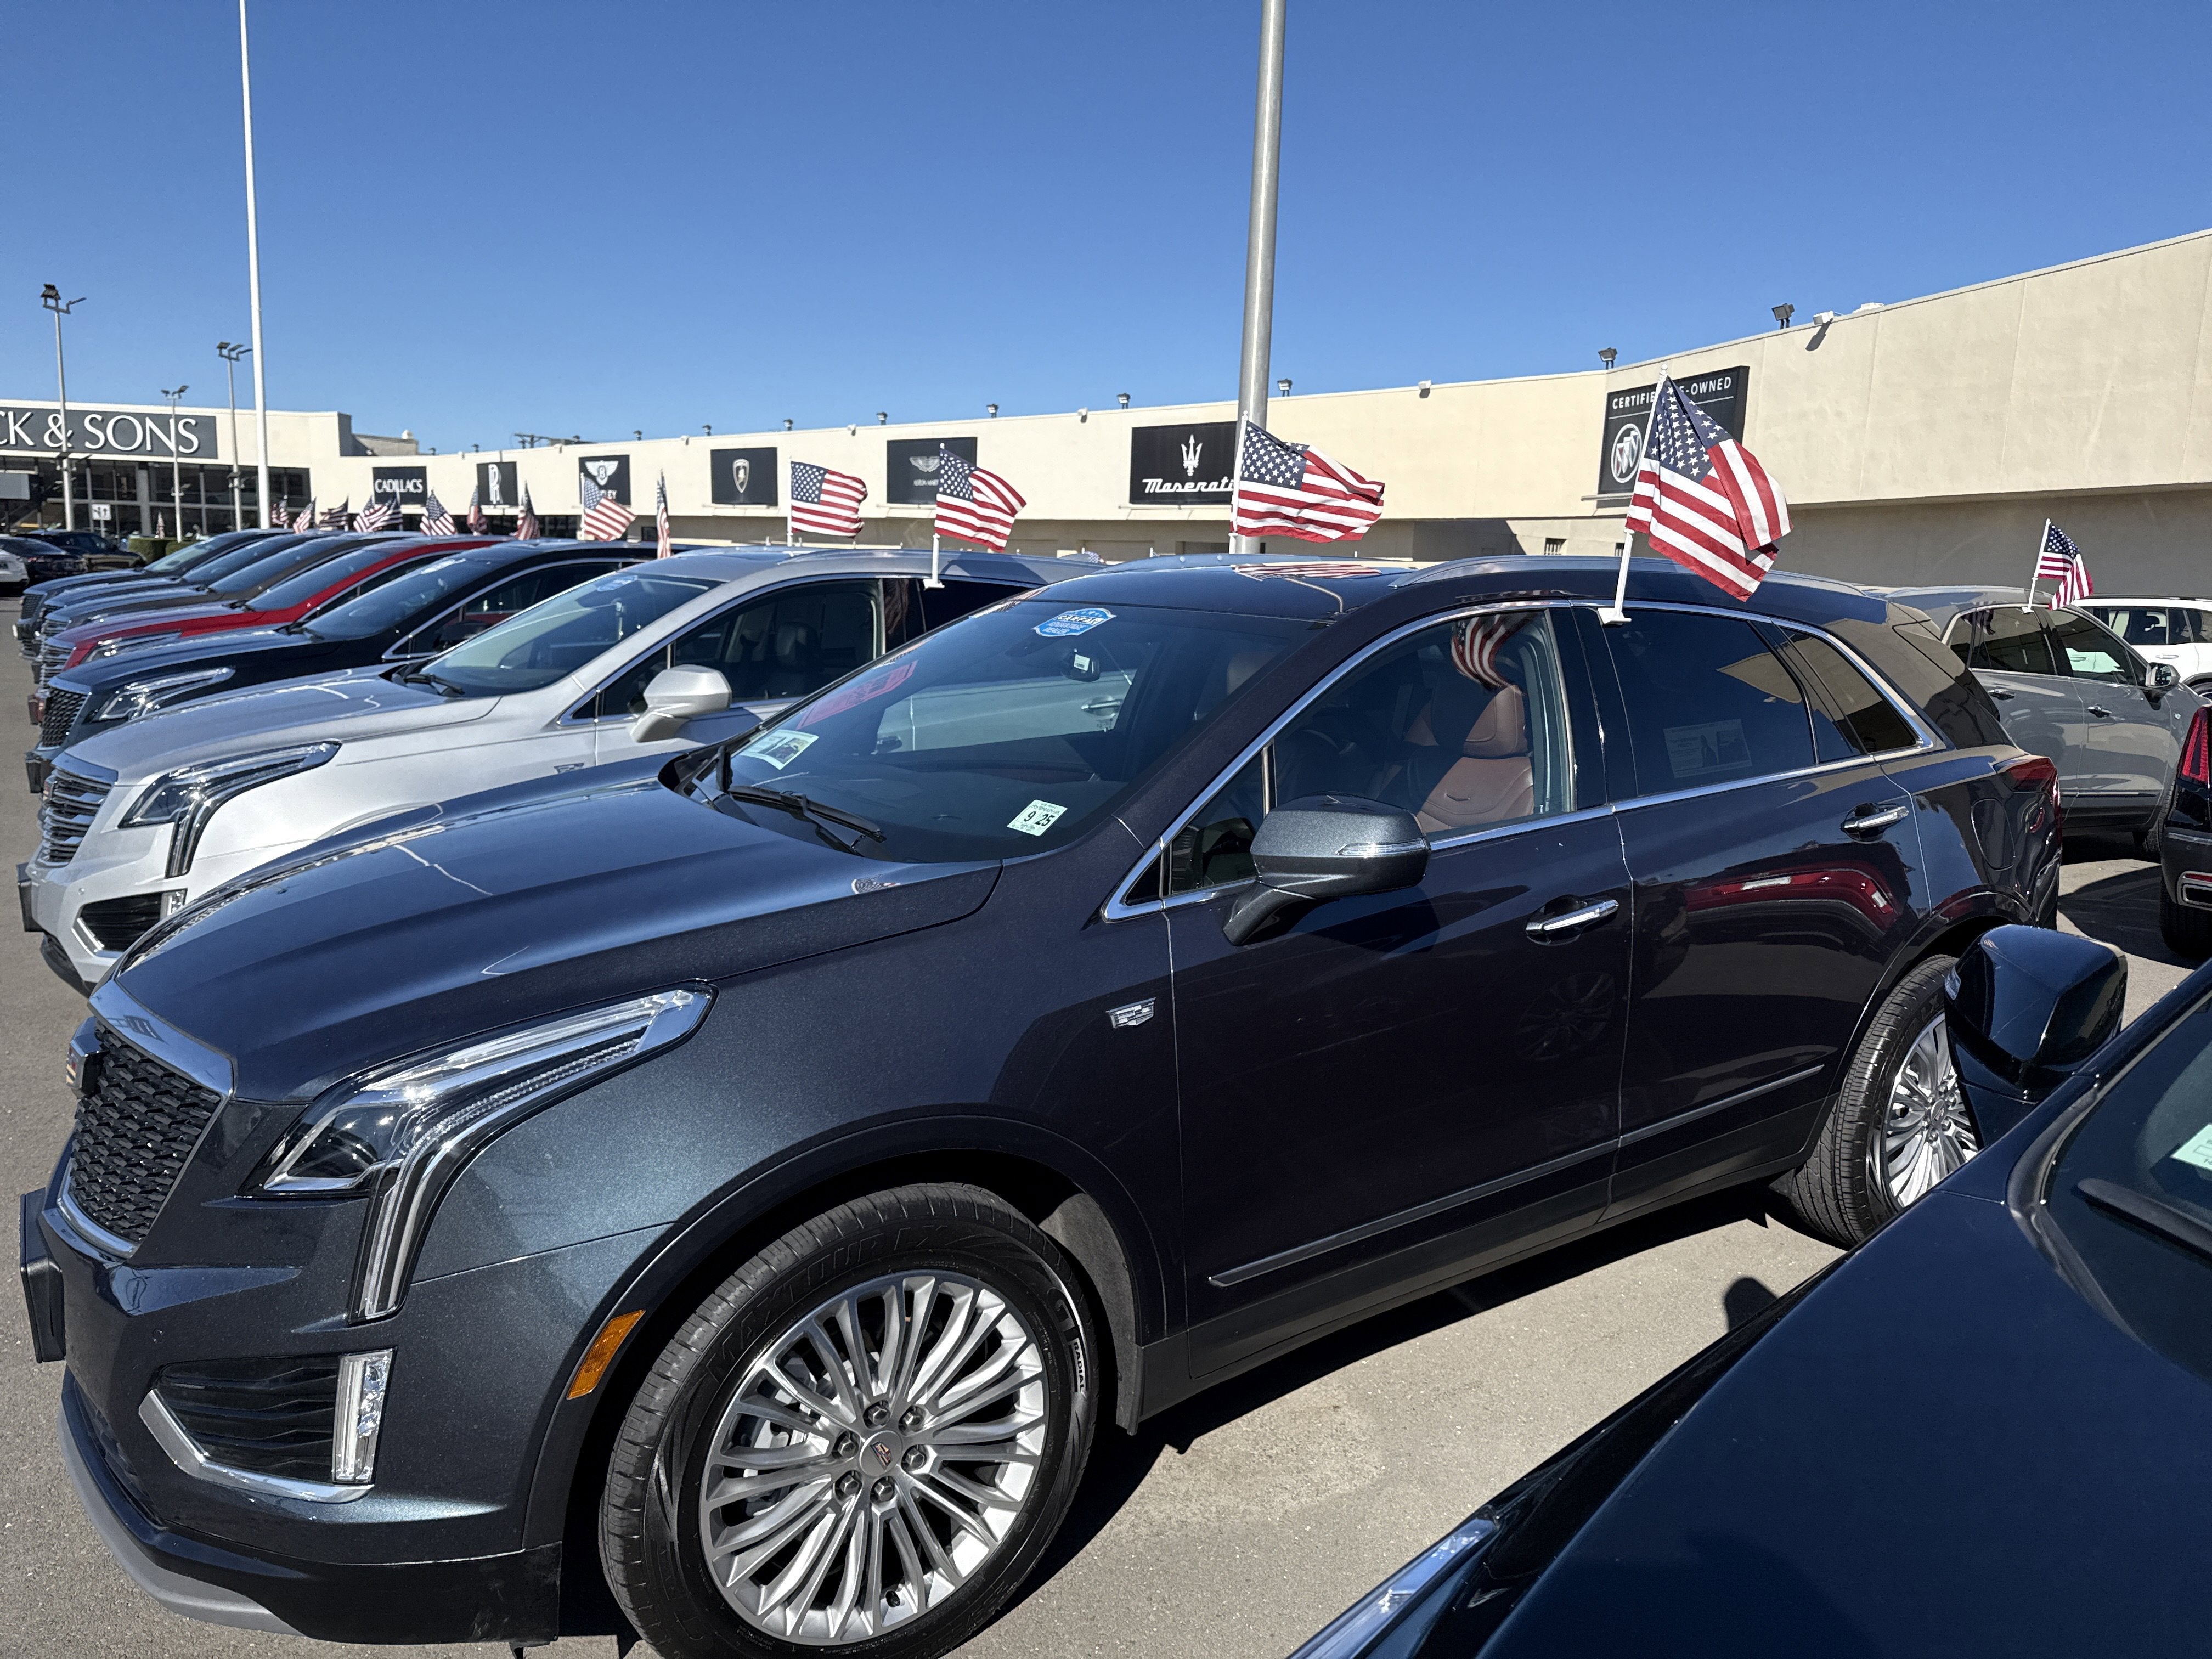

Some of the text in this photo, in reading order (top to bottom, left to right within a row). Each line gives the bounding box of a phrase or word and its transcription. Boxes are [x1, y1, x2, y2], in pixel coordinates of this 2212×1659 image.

[1612, 391, 1655, 410] CERTIFIE
[0, 410, 199, 454] K & SONS
[375, 478, 423, 493] CADILLACS
[1142, 476, 1234, 493] Maserati
[1023, 811, 1037, 822] 9
[1034, 813, 1056, 827] 25
[1074, 1341, 1085, 1393] RADIAL
